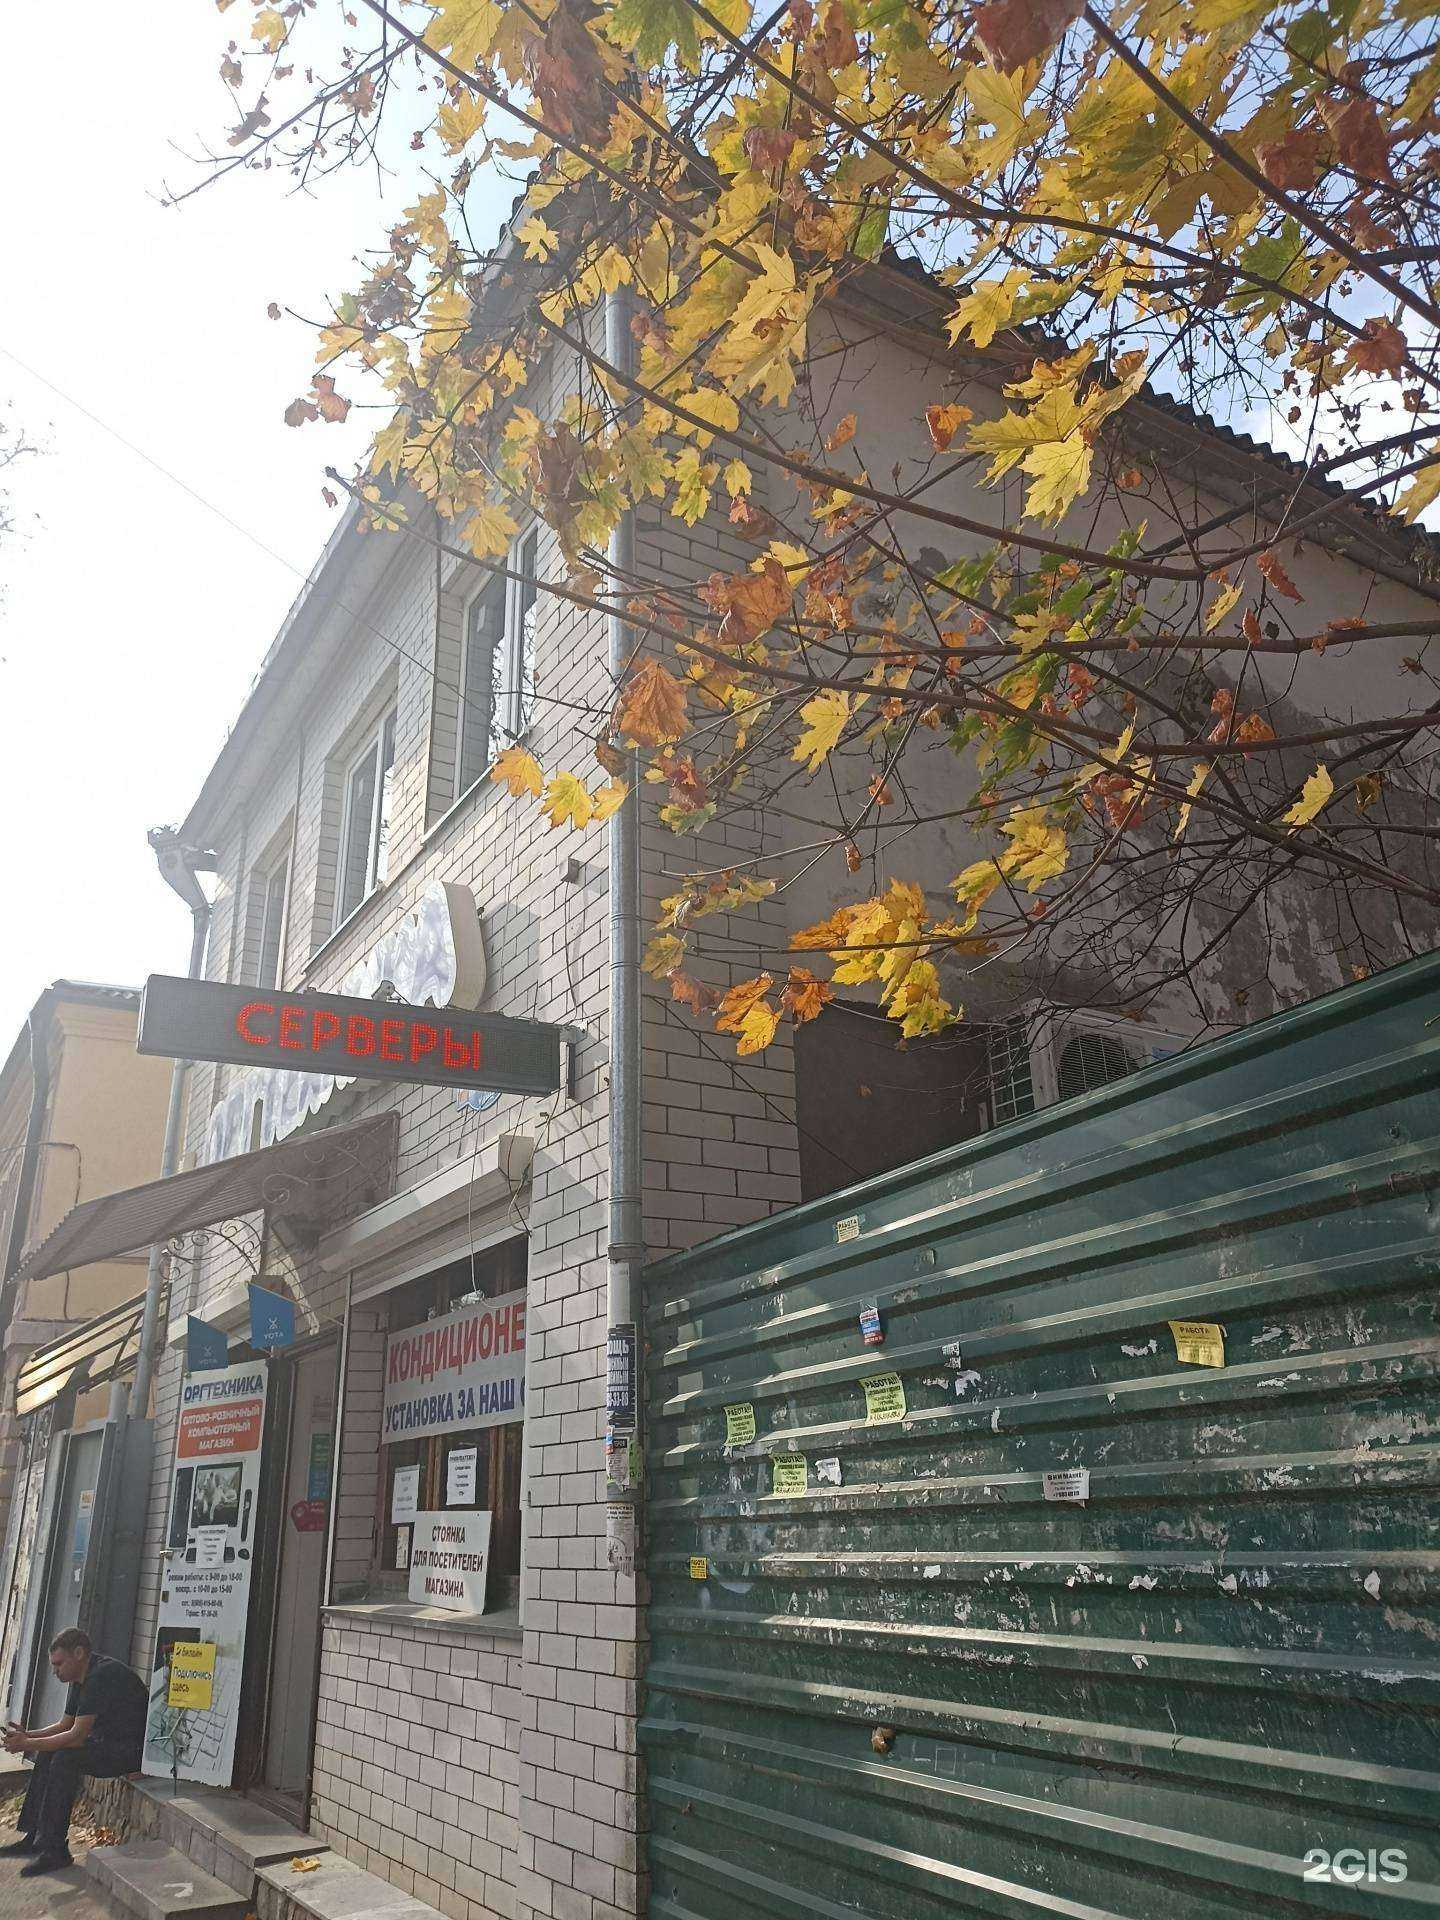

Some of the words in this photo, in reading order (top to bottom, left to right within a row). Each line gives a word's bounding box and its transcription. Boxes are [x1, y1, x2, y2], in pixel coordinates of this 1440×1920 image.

[236, 1002, 481, 1072] СЕРВЕРЫ
[388, 1301, 526, 1385] КОНДИЦИОНЕ
[183, 1374, 263, 1401] ОРГТЕХНИКА
[385, 1392, 454, 1433] УСТАНОВКА
[458, 1387, 475, 1420] ЗА
[479, 1378, 515, 1415] НАШ
[187, 1419, 251, 1439] КОМПЬЮТЕРНЫЙ
[198, 1437, 234, 1450] МАГАЗИН
[432, 1525, 466, 1544] СТОЯНКА
[412, 1549, 428, 1569] ДЛЯ
[428, 1551, 484, 1573] ПОСЕТИТЕЛЕЙ
[425, 1577, 464, 1598] МАГАЗИНА
